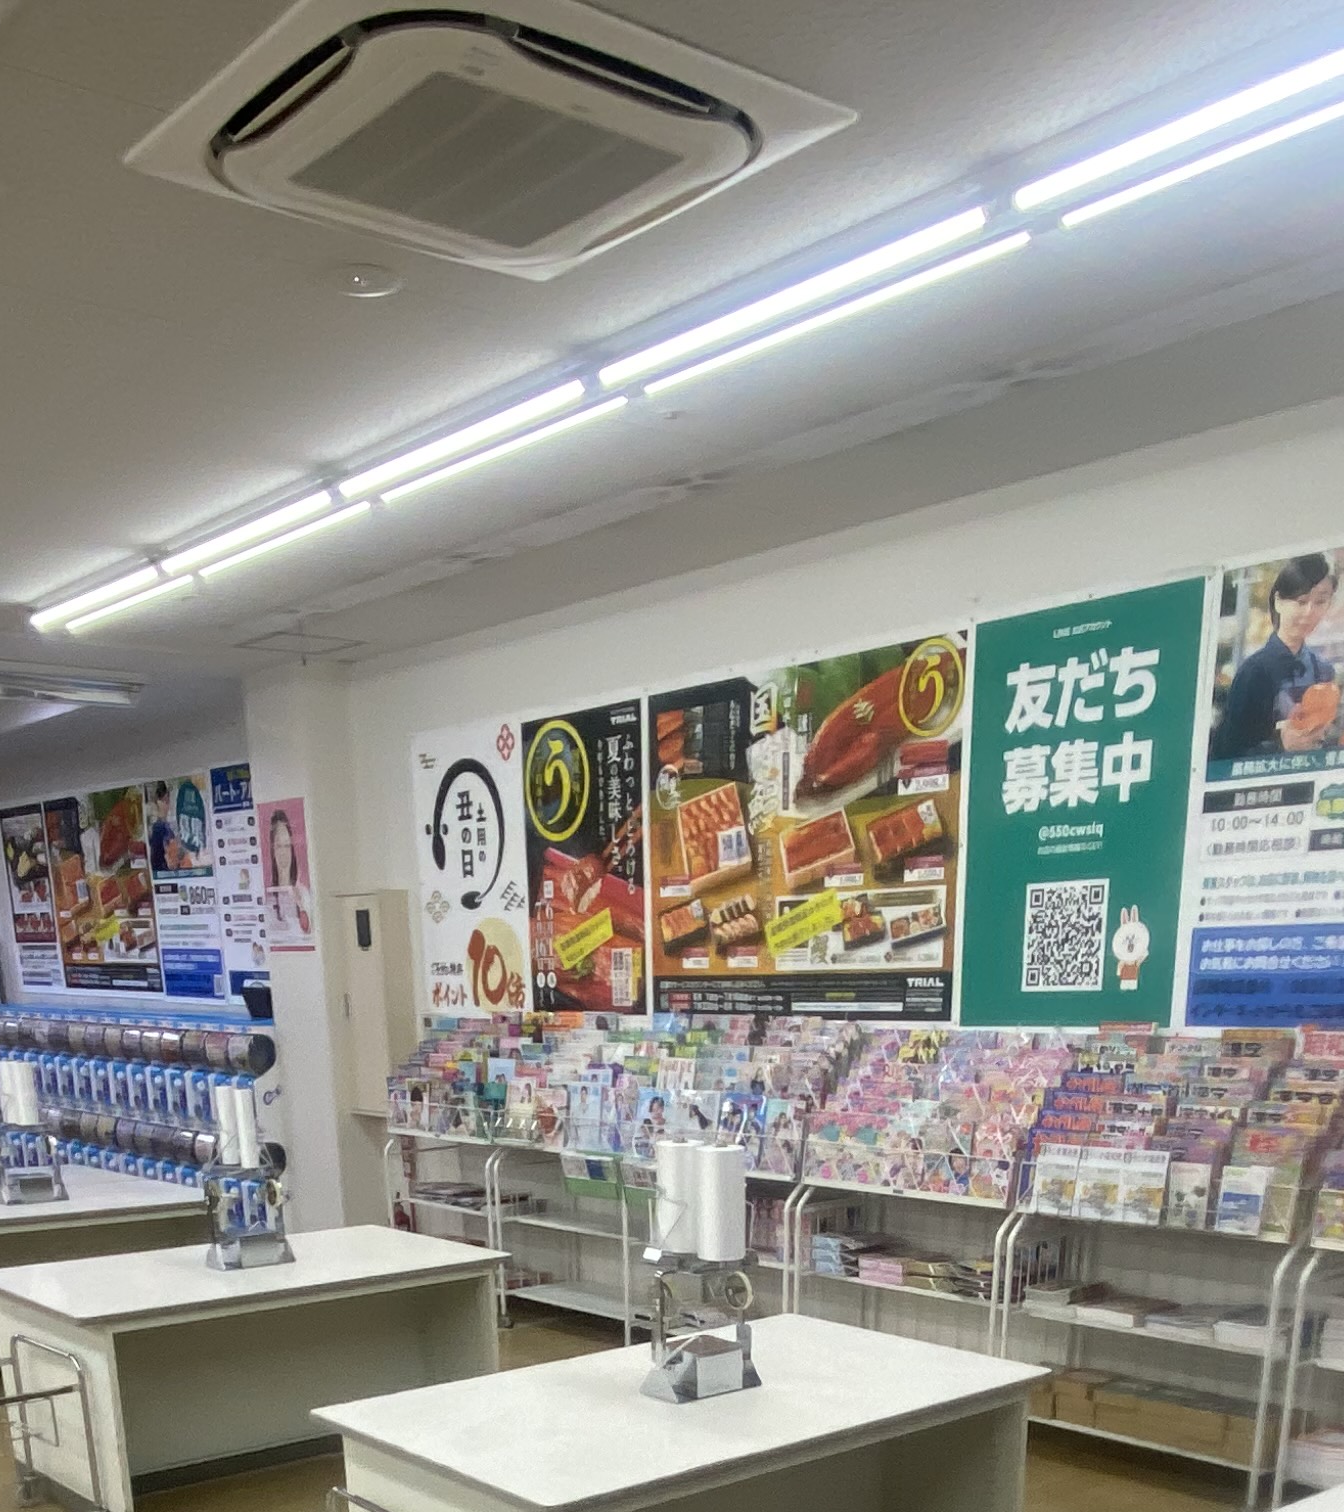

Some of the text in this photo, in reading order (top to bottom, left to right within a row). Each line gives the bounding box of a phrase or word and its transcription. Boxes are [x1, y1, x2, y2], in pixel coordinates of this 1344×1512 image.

[1004, 646, 1161, 735] 友だち
[1001, 731, 1154, 816] 募集中
[906, 976, 945, 988] TRIAL
